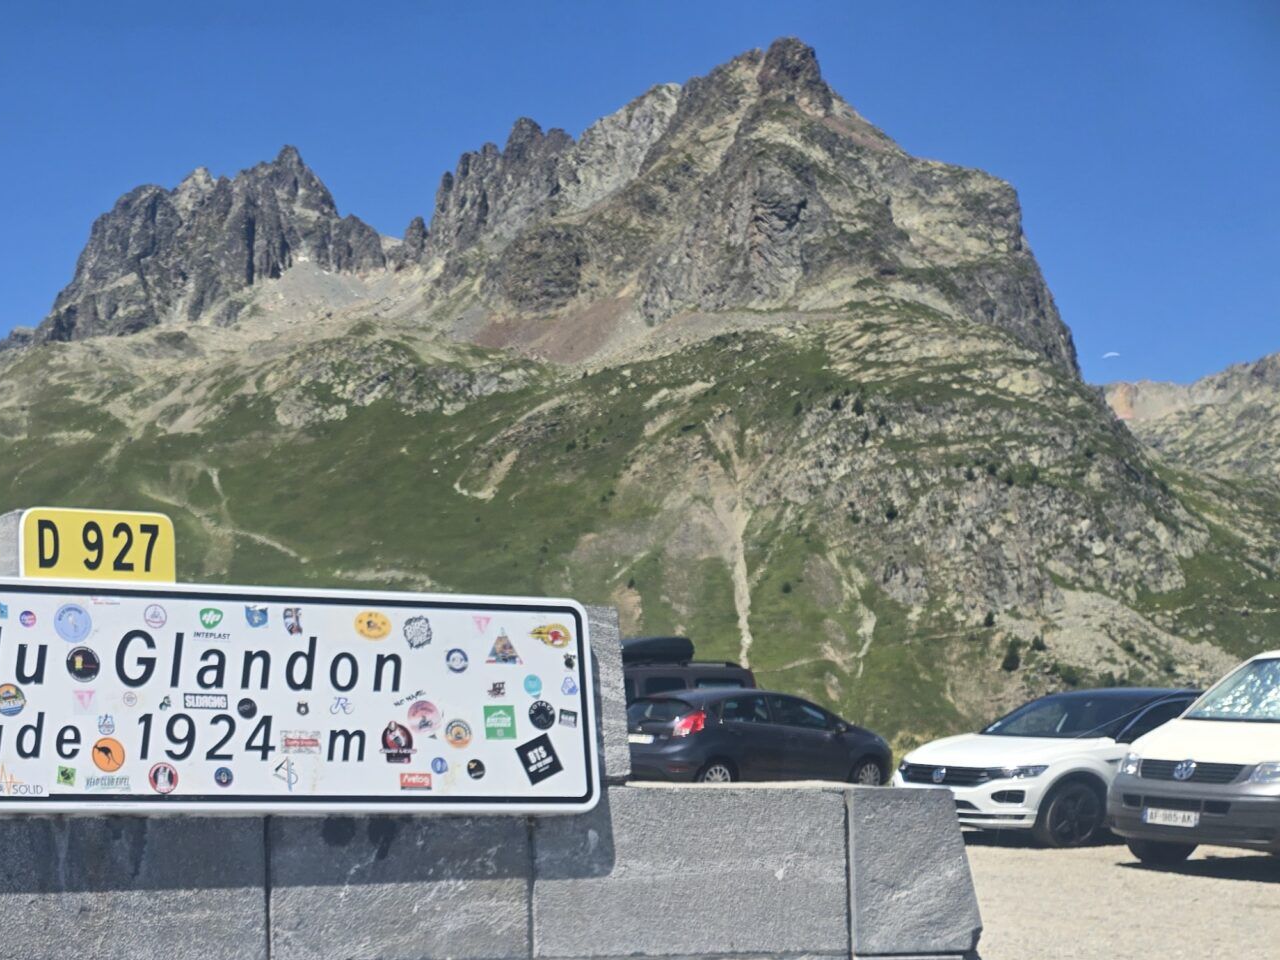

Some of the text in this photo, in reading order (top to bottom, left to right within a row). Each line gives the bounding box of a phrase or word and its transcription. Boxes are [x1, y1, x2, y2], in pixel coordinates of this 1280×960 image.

[37, 519, 160, 573] D 927
[193, 631, 231, 640] INTEPLAST
[115, 629, 402, 692] Glandon
[529, 700, 555, 716] VOYAGE
[137, 712, 277, 762] 1924
[326, 729, 366, 762] m
[12, 784, 44, 795] SOLID
